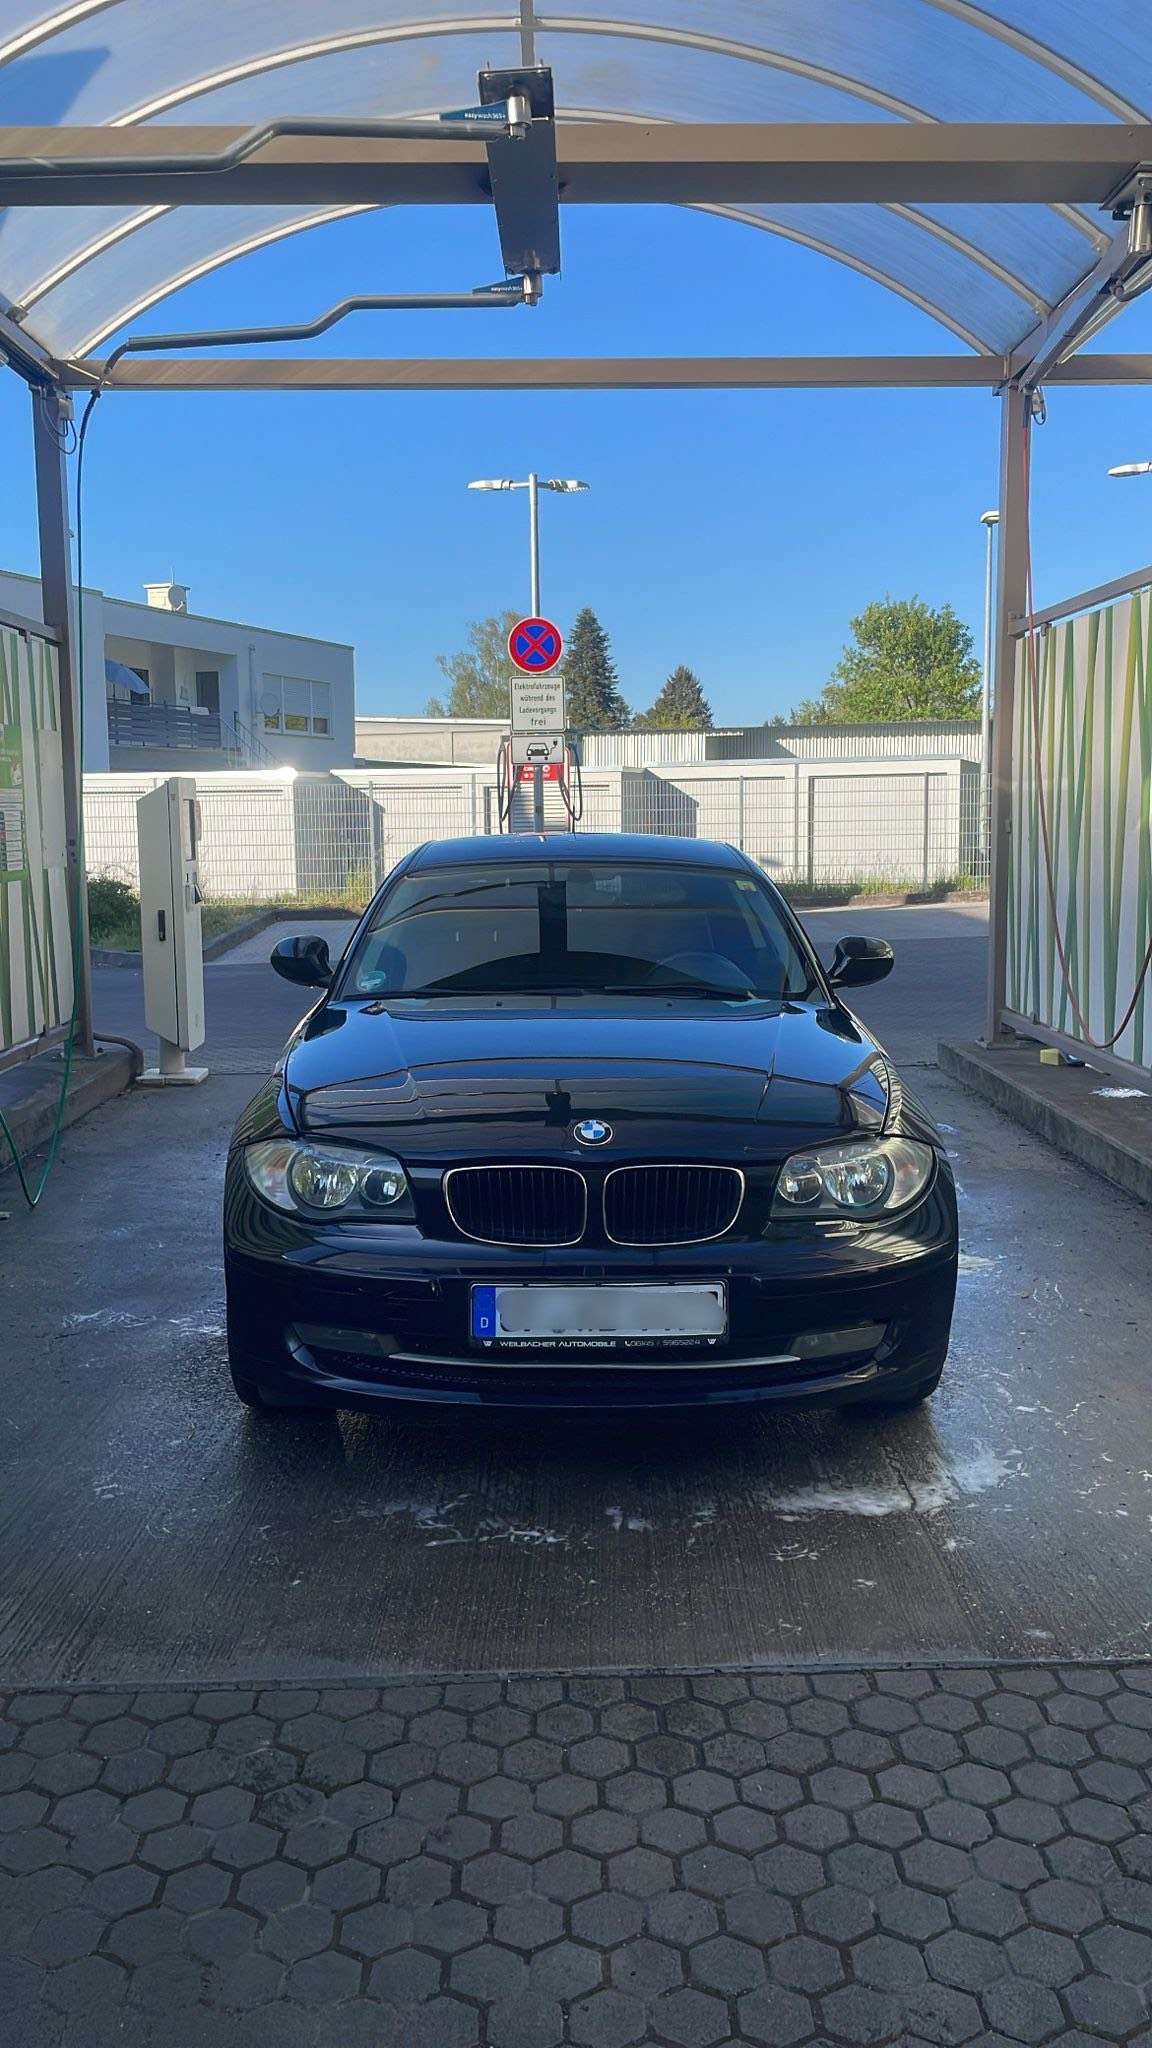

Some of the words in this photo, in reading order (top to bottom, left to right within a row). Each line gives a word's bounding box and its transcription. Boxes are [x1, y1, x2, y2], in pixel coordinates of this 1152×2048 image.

[480, 1317, 489, 1328] D
[500, 1340, 556, 1348] WEILBACHER
[558, 1340, 617, 1348] AUTOMOBILE
